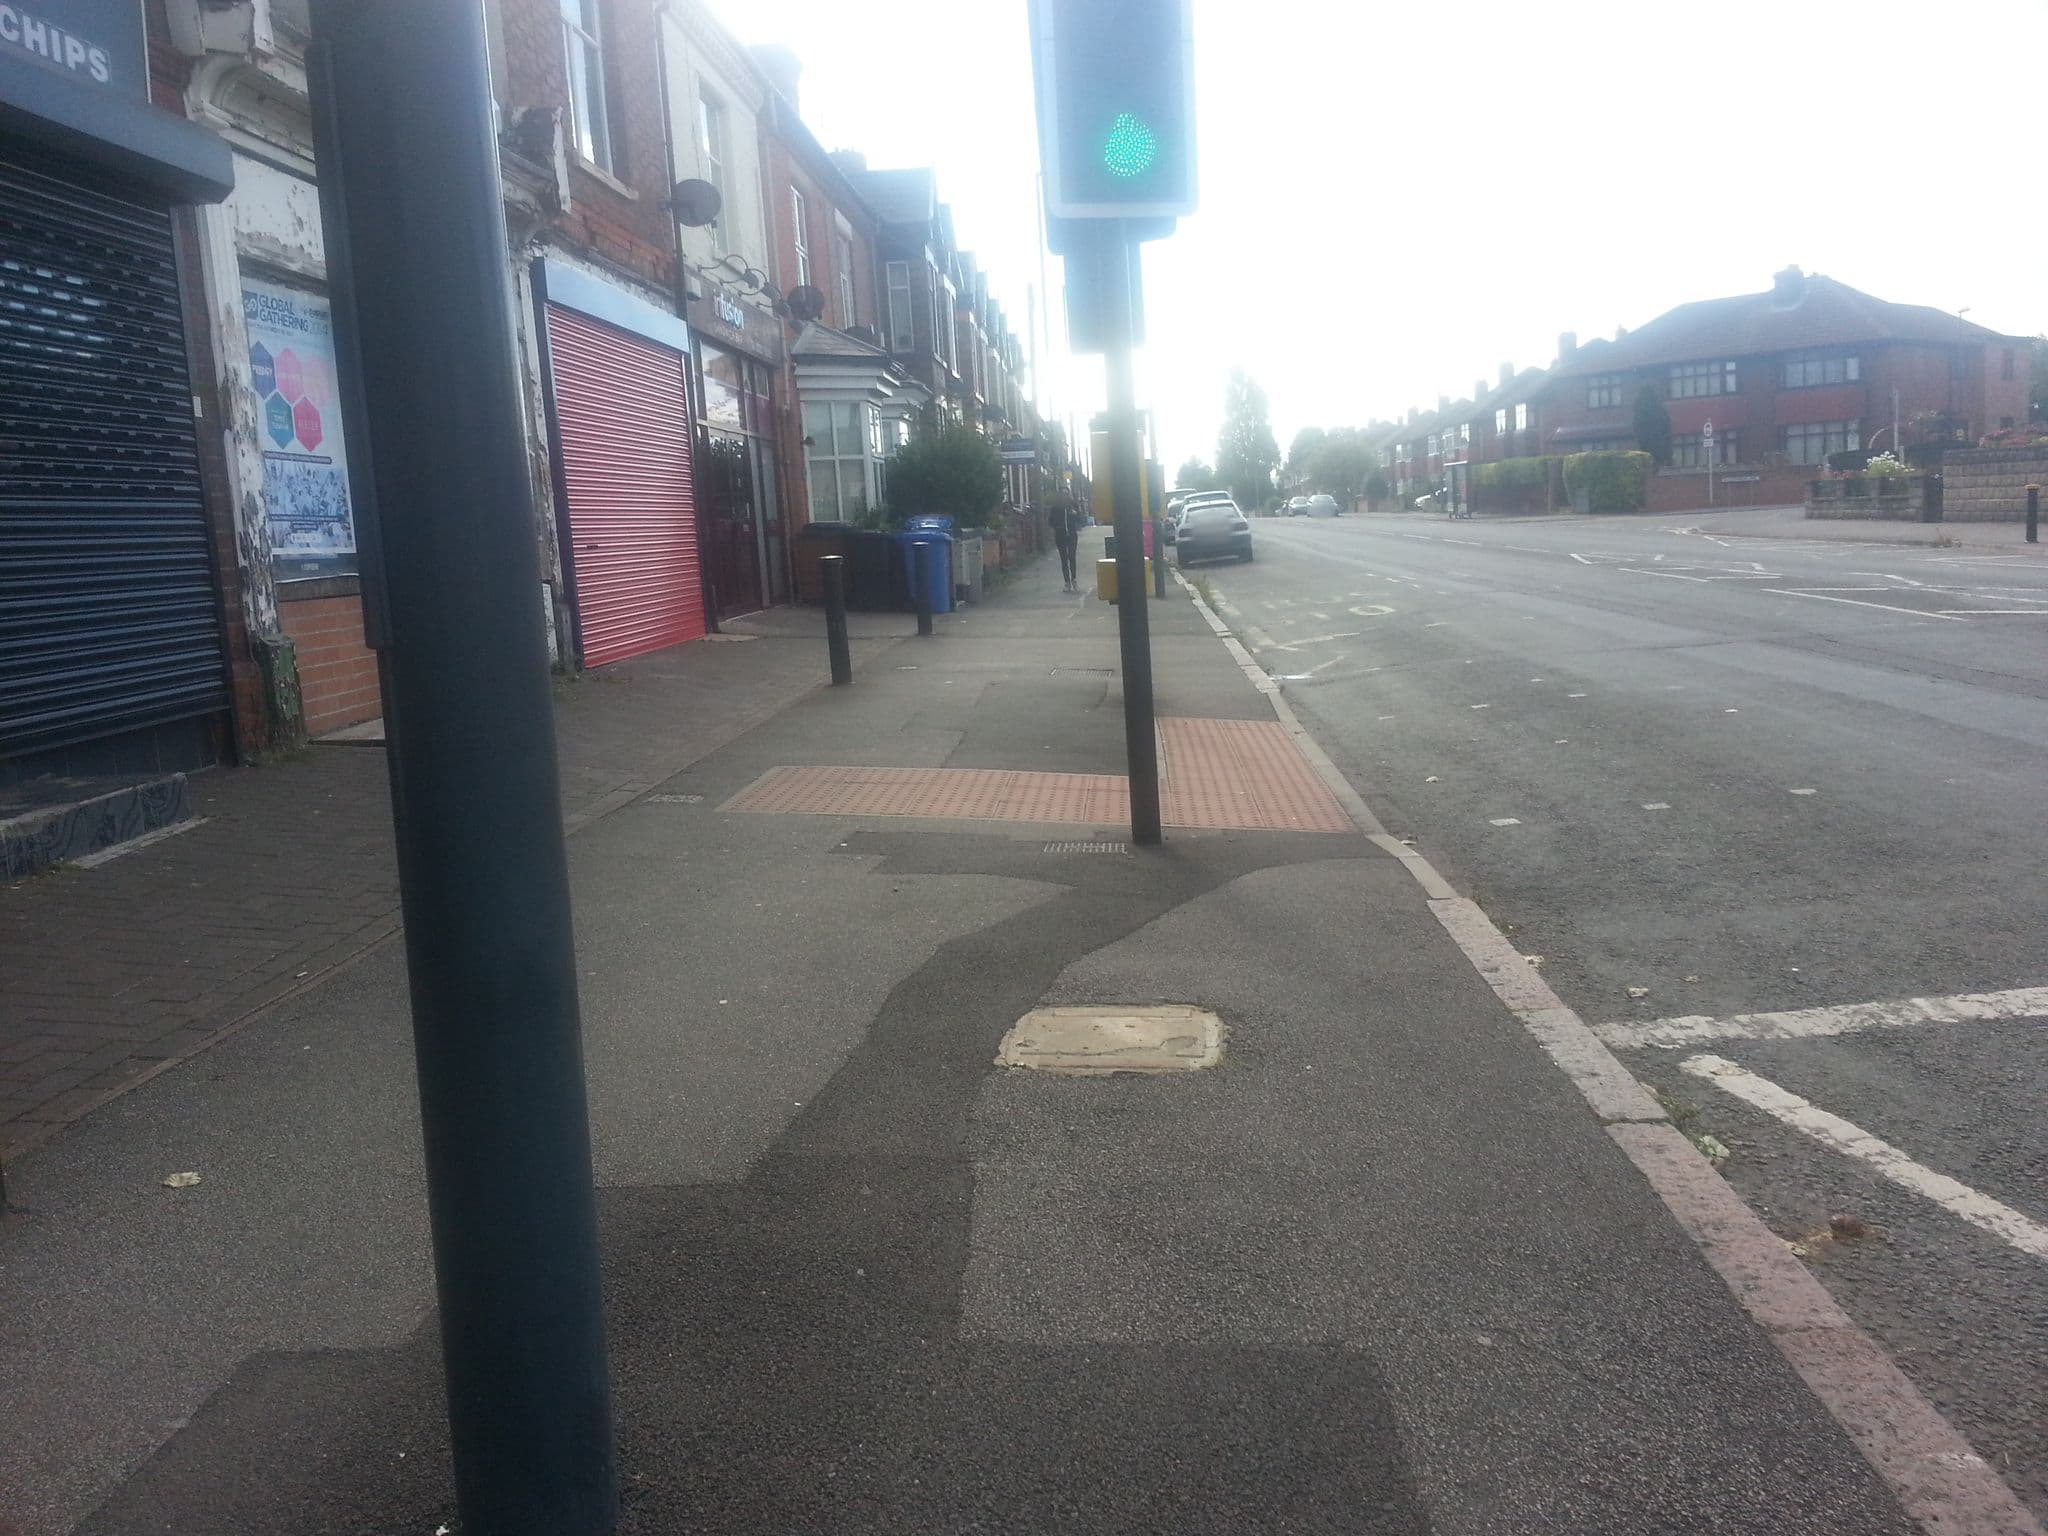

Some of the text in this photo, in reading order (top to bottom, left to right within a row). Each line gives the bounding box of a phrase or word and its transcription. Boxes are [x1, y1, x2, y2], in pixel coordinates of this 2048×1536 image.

[0, 4, 109, 82] CHIPS
[259, 295, 295, 315] GLOBAL
[259, 309, 309, 332] GATHERING
